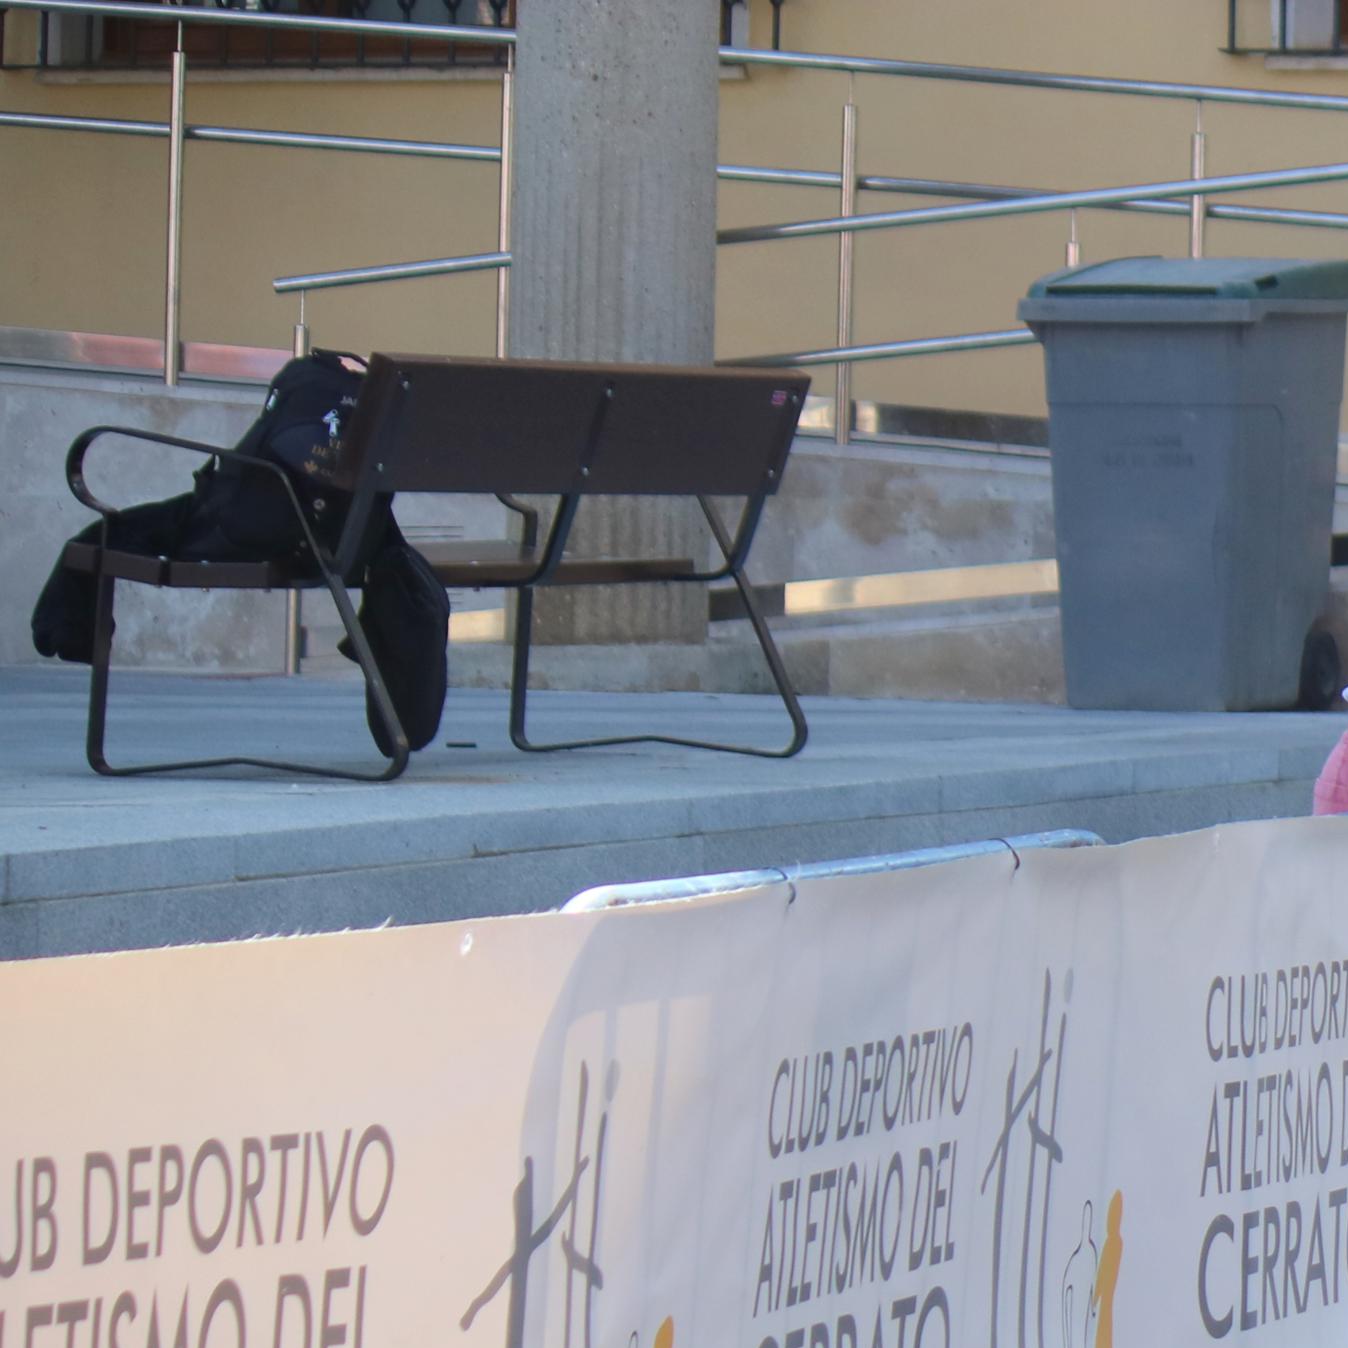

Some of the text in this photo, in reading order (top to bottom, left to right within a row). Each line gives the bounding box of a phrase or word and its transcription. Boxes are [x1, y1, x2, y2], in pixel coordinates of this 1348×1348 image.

[1205, 967, 1268, 1062] CLUB
[768, 1021, 975, 1160] CLUB DEPORTIVO
[1200, 1060, 1335, 1197] ATLETISMO
[82, 1123, 395, 1267] DEPORTIVO
[754, 1140, 958, 1319] ATLETISMO DEL
